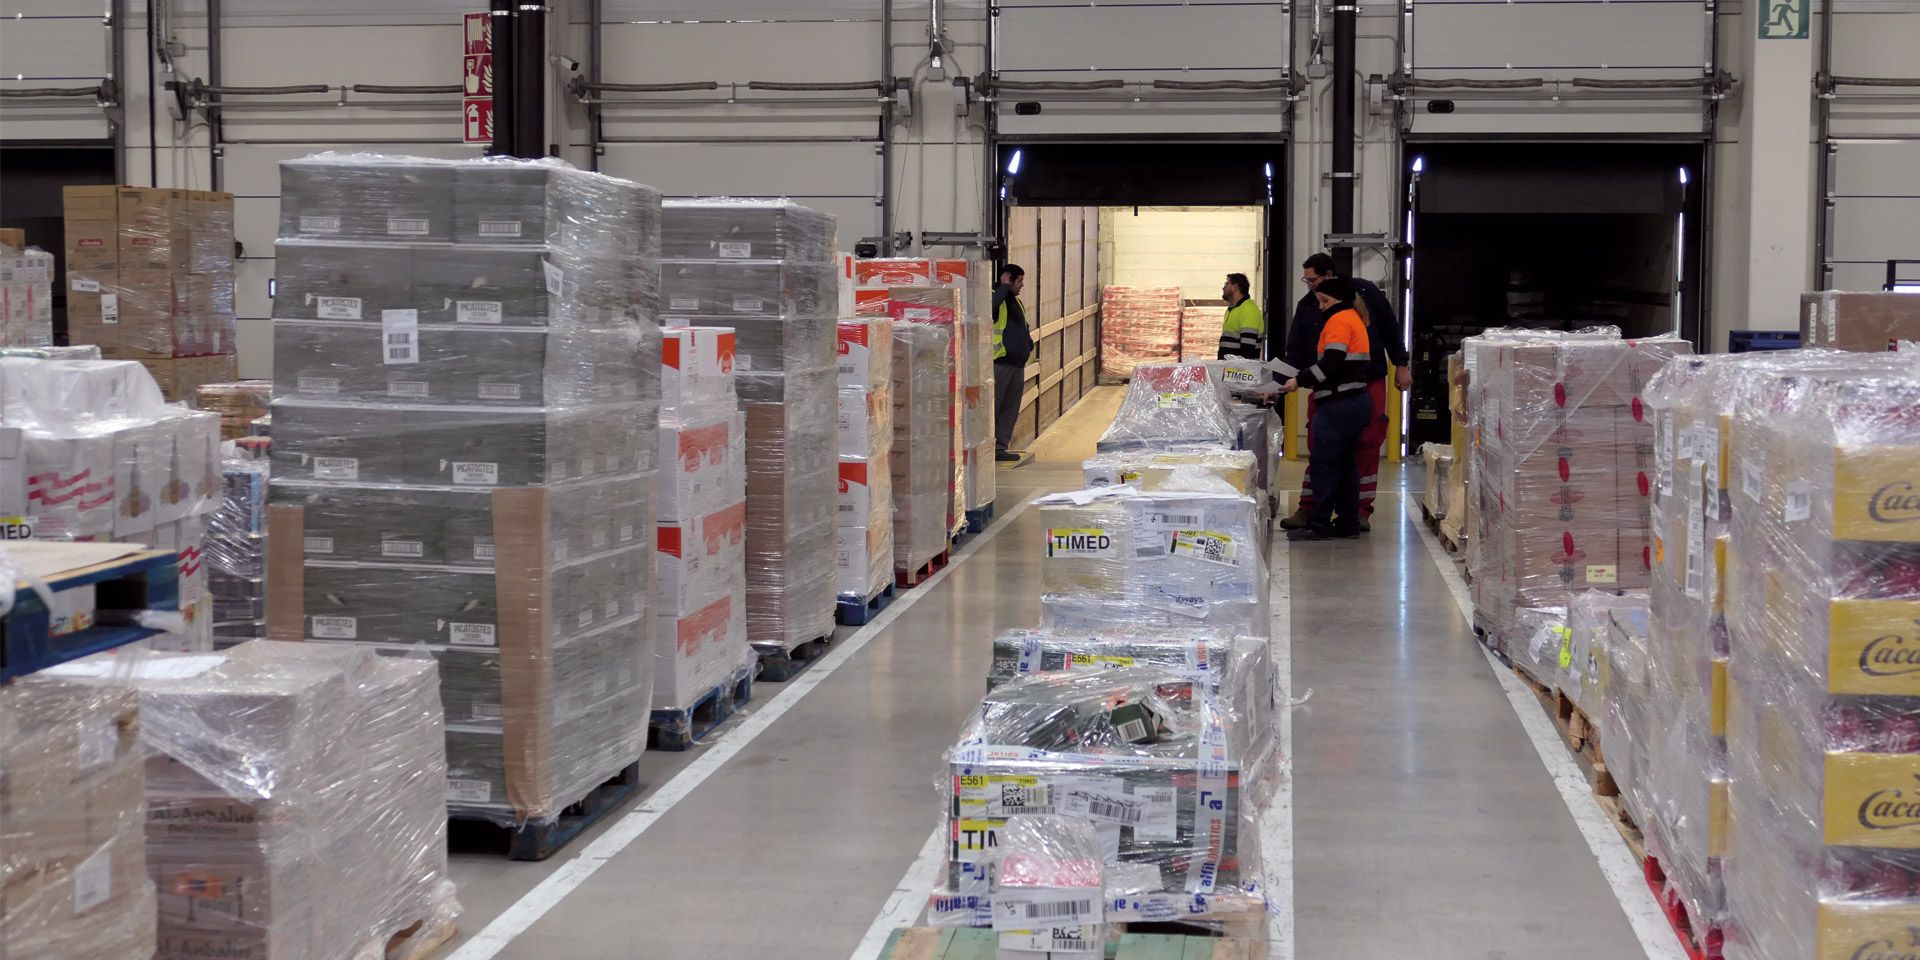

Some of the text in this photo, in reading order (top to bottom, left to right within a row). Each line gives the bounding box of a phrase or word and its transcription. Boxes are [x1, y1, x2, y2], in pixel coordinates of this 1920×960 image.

[459, 303, 499, 313] PICATOSTES
[1226, 370, 1254, 381] TIMED
[456, 463, 494, 474] PICATOSTES
[1055, 535, 1110, 549] TIMED
[315, 618, 353, 629] PICATOSTES
[454, 624, 492, 635] PICATOSTES
[1071, 653, 1091, 664] E561
[960, 775, 984, 786] E561
